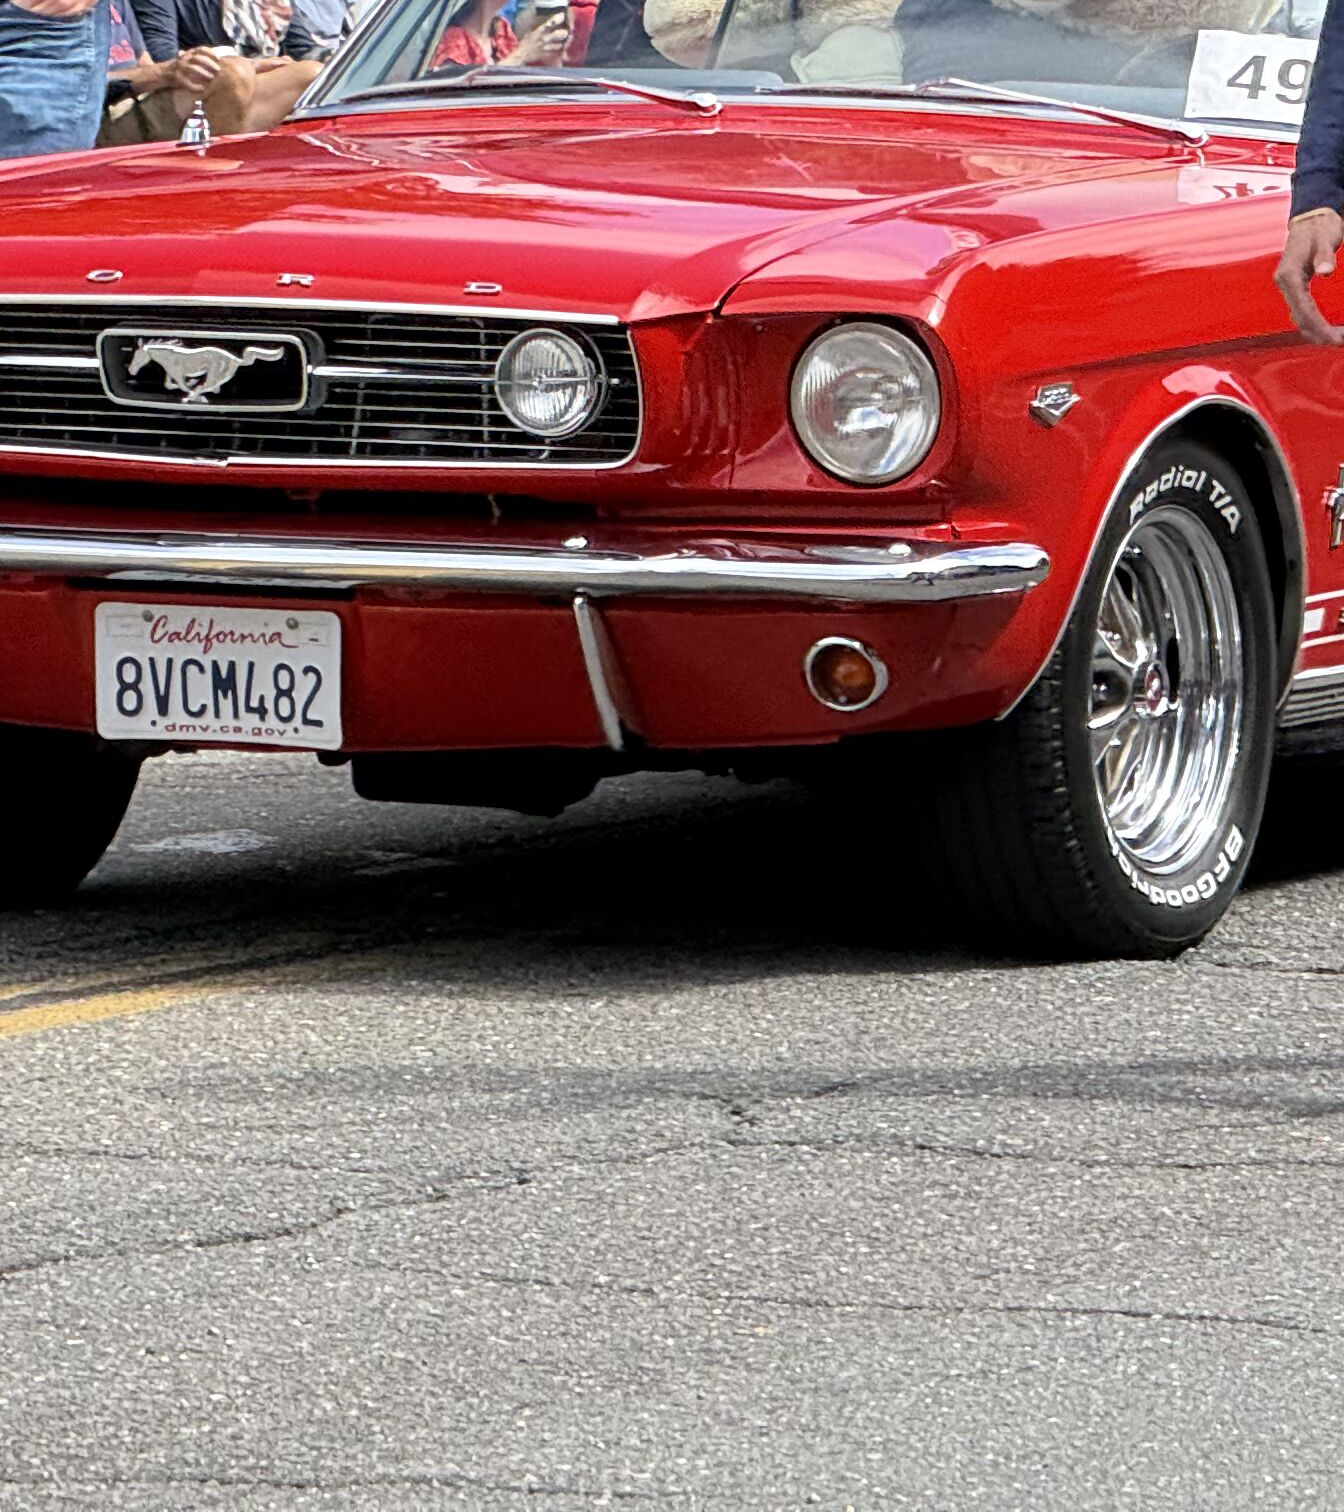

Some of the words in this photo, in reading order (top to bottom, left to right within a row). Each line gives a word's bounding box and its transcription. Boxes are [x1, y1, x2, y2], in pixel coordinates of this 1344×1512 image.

[1226, 55, 1314, 105] 49
[1129, 464, 1207, 526] Radial
[1209, 478, 1242, 535] T/A
[149, 614, 300, 655] California
[116, 656, 325, 729] 8VCM482
[164, 722, 288, 737] dmv.ca.gov
